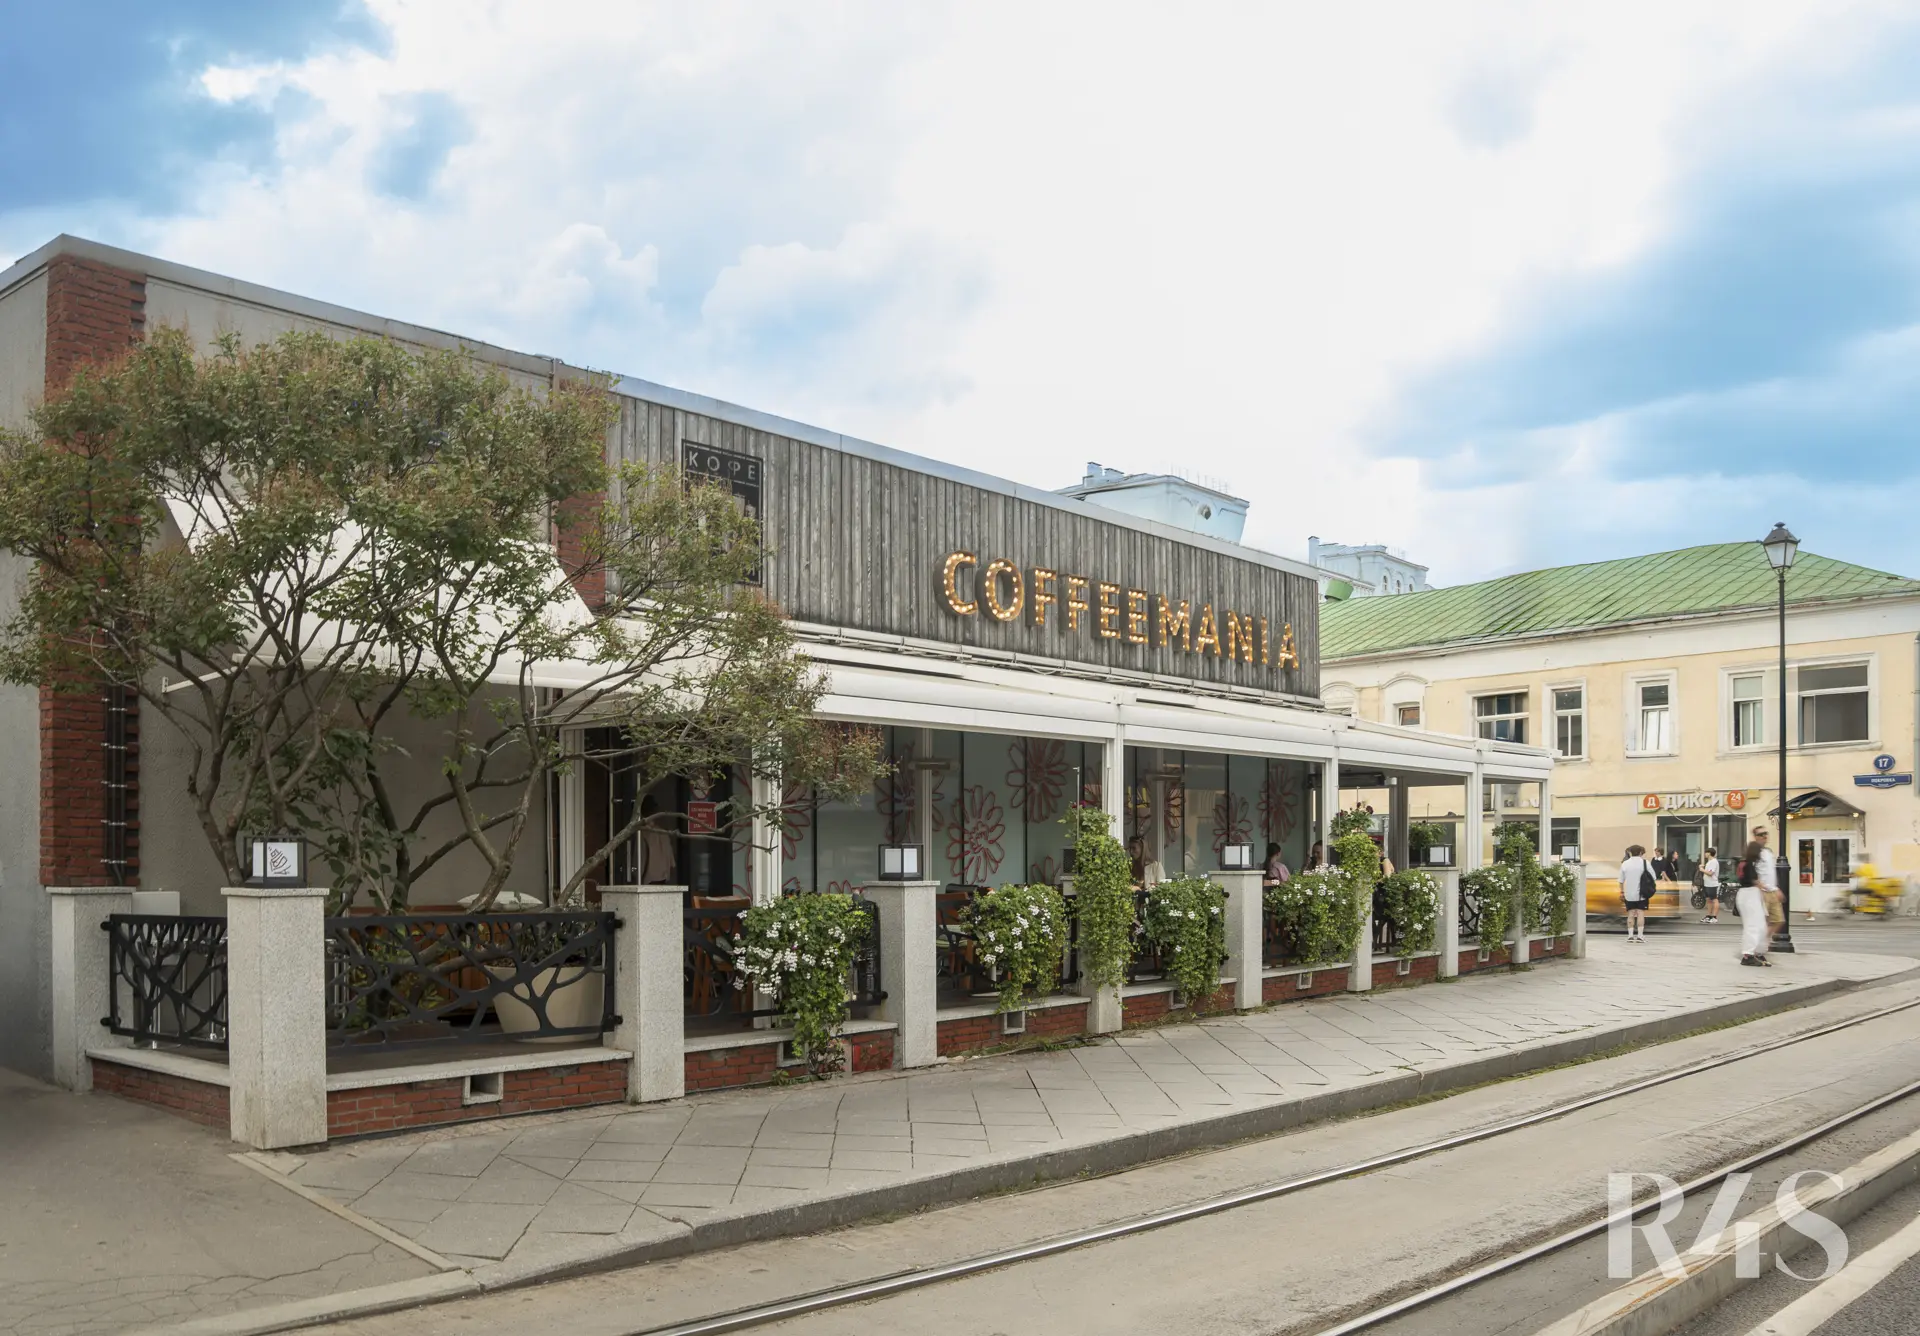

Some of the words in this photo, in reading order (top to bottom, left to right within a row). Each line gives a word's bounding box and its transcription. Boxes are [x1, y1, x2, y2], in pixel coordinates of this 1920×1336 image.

[688, 451, 756, 480] КОФЕ
[934, 550, 1299, 672] COFFEEMANIA
[1878, 758, 1889, 768] 17
[1647, 797, 1656, 807] Д
[1664, 792, 1724, 811] ДИКСИ
[1730, 792, 1741, 801] 24
